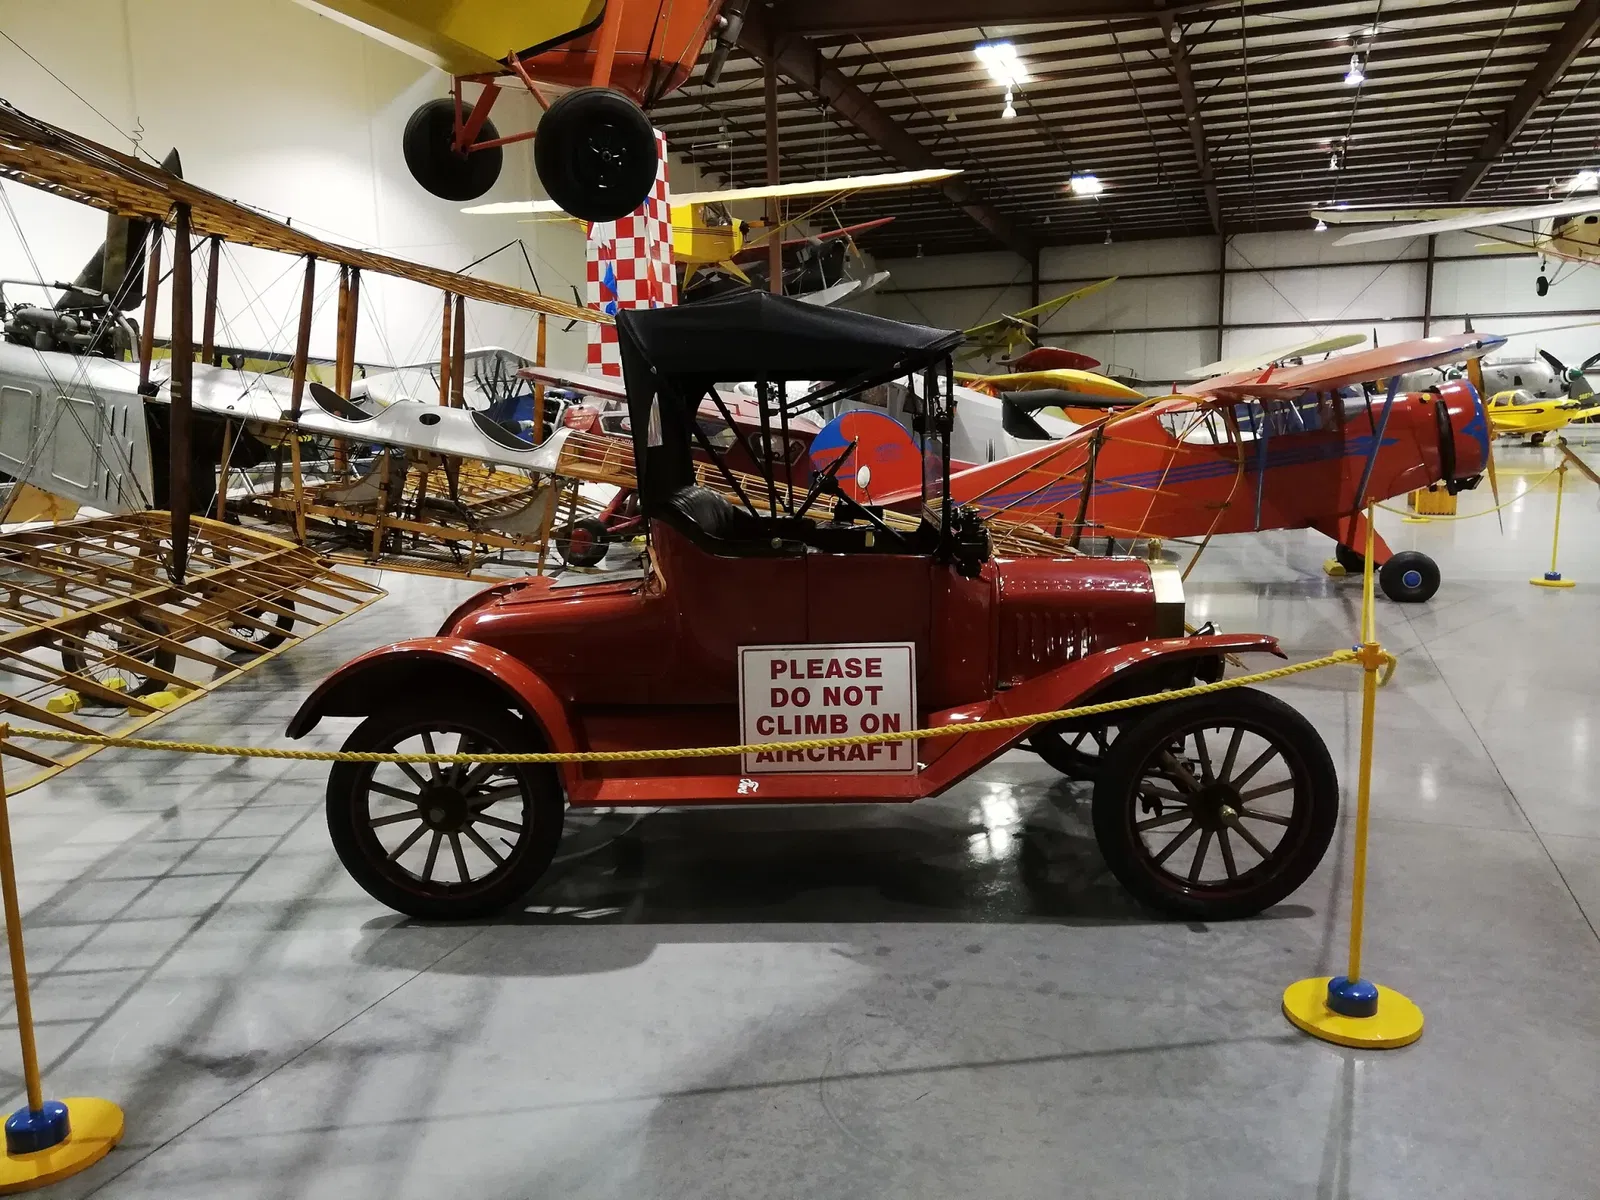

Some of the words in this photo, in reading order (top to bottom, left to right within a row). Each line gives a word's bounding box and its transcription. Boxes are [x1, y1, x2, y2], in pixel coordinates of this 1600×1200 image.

[770, 658, 883, 680] PLEASE
[770, 687, 811, 707] DO
[823, 685, 883, 706] NOT
[756, 714, 849, 736] CLIMB
[860, 713, 900, 734] ON
